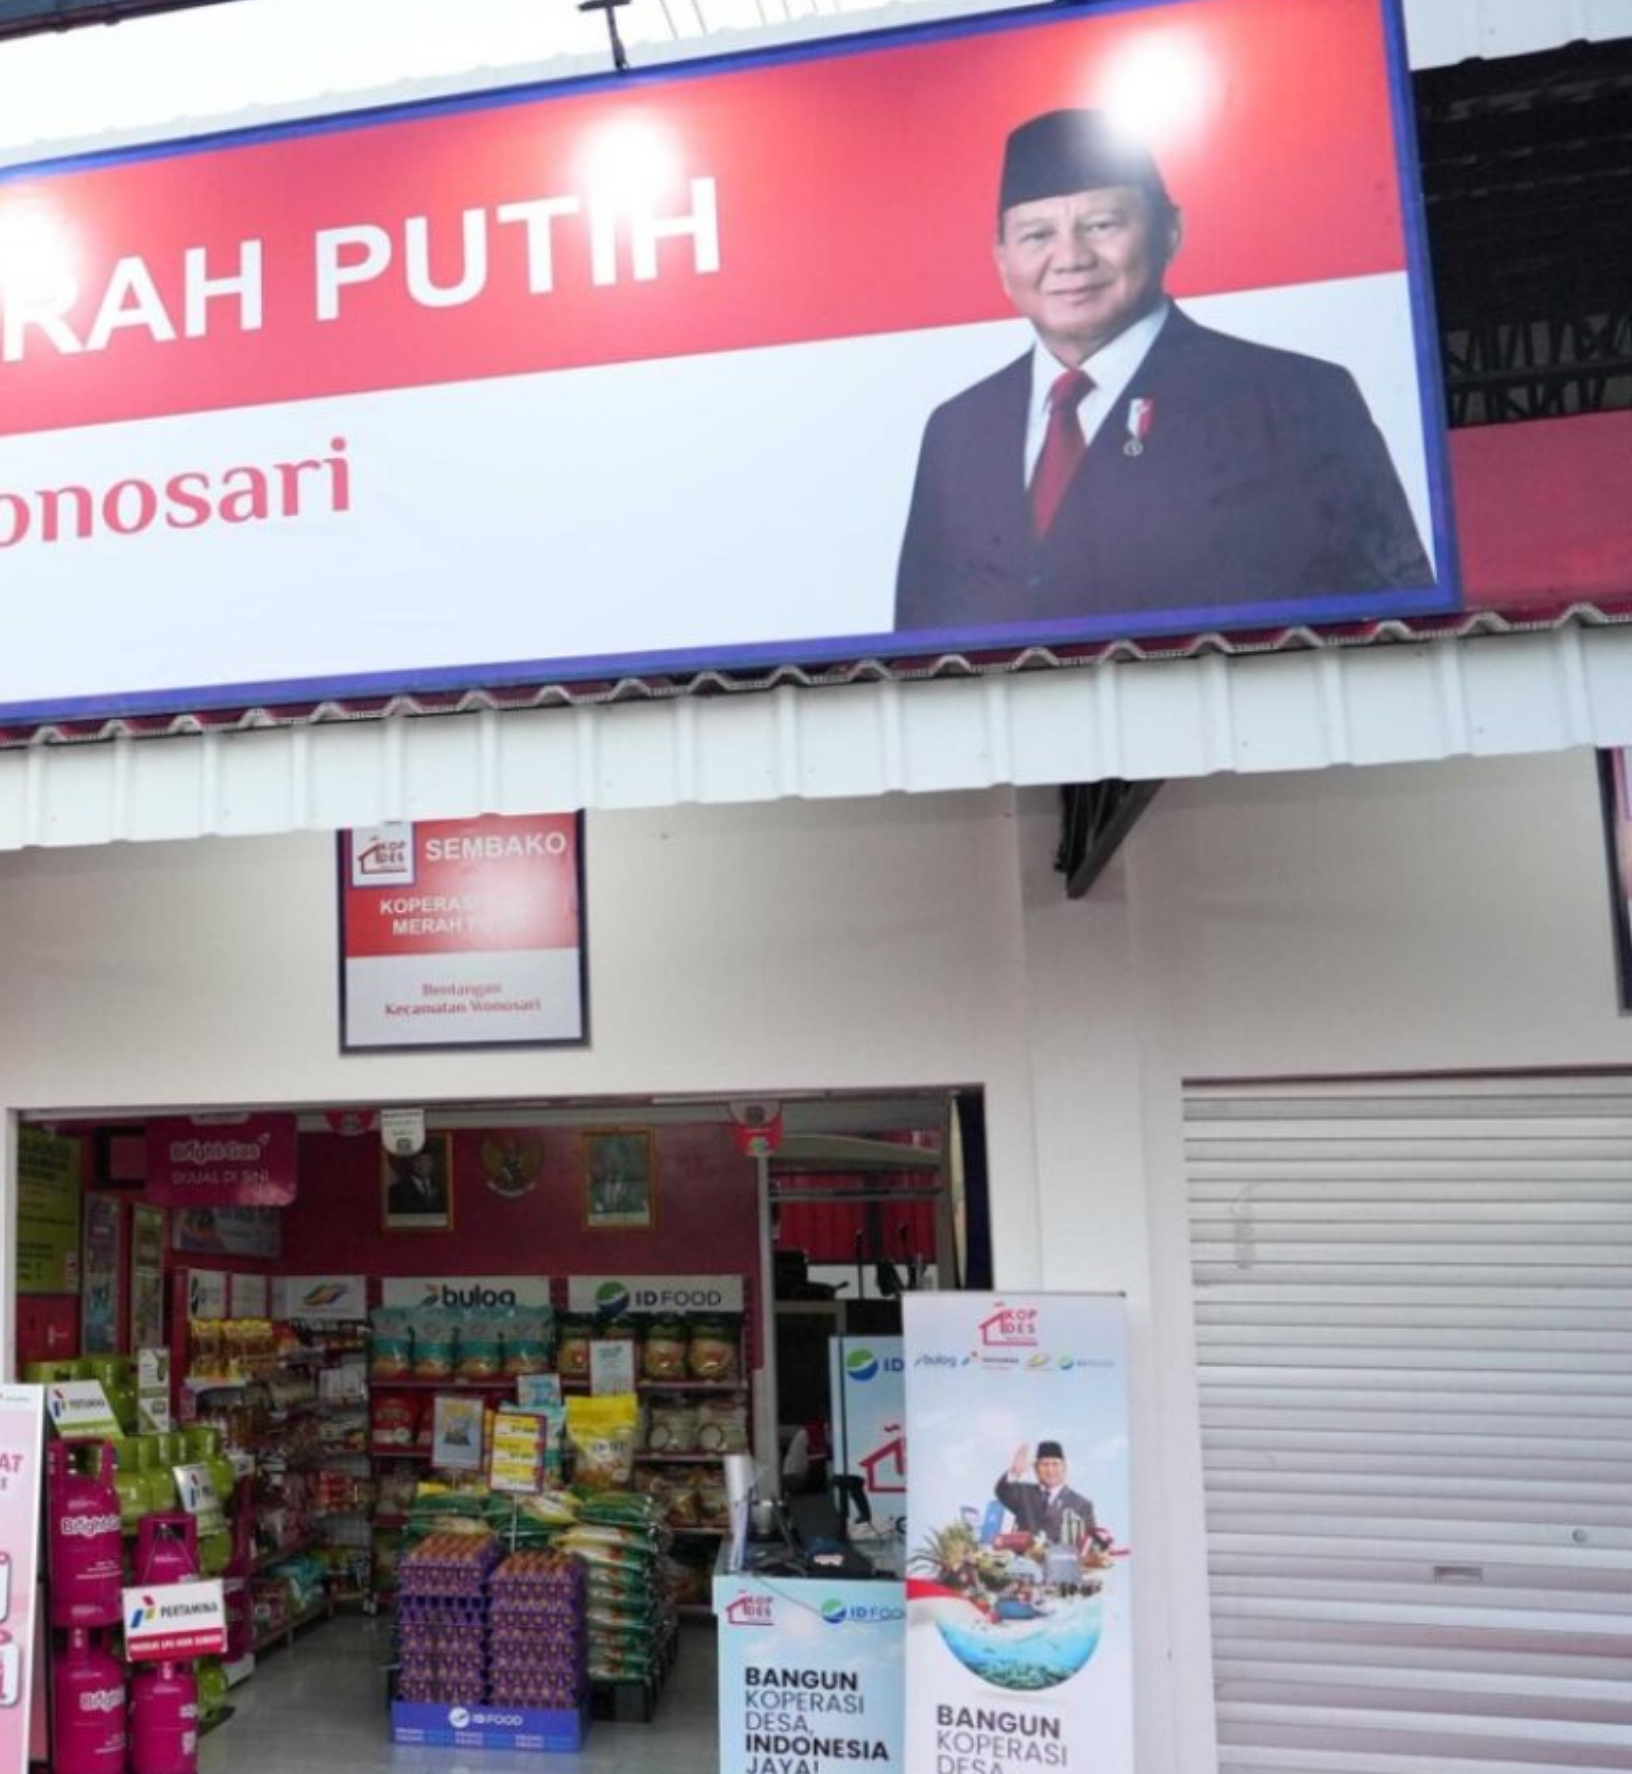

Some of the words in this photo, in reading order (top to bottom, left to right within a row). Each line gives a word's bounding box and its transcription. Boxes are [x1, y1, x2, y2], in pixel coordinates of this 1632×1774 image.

[315, 176, 719, 321] PUTIH
[425, 832, 566, 861] SEMBAKO
[380, 897, 473, 915] KOPERA
[392, 917, 462, 935] MERAH
[385, 1001, 466, 1017] Kecamatan
[635, 1289, 658, 1306] ID
[661, 1289, 722, 1305] FOOD
[850, 1607, 868, 1619] ID
[745, 1667, 858, 1691] BANGUN
[745, 1690, 865, 1714] KOPERASI
[745, 1712, 814, 1736] DESA,
[937, 1705, 1060, 1739] BANGUN
[745, 1734, 890, 1761] INDONESIA
[937, 1730, 1067, 1766] KOPERASI
